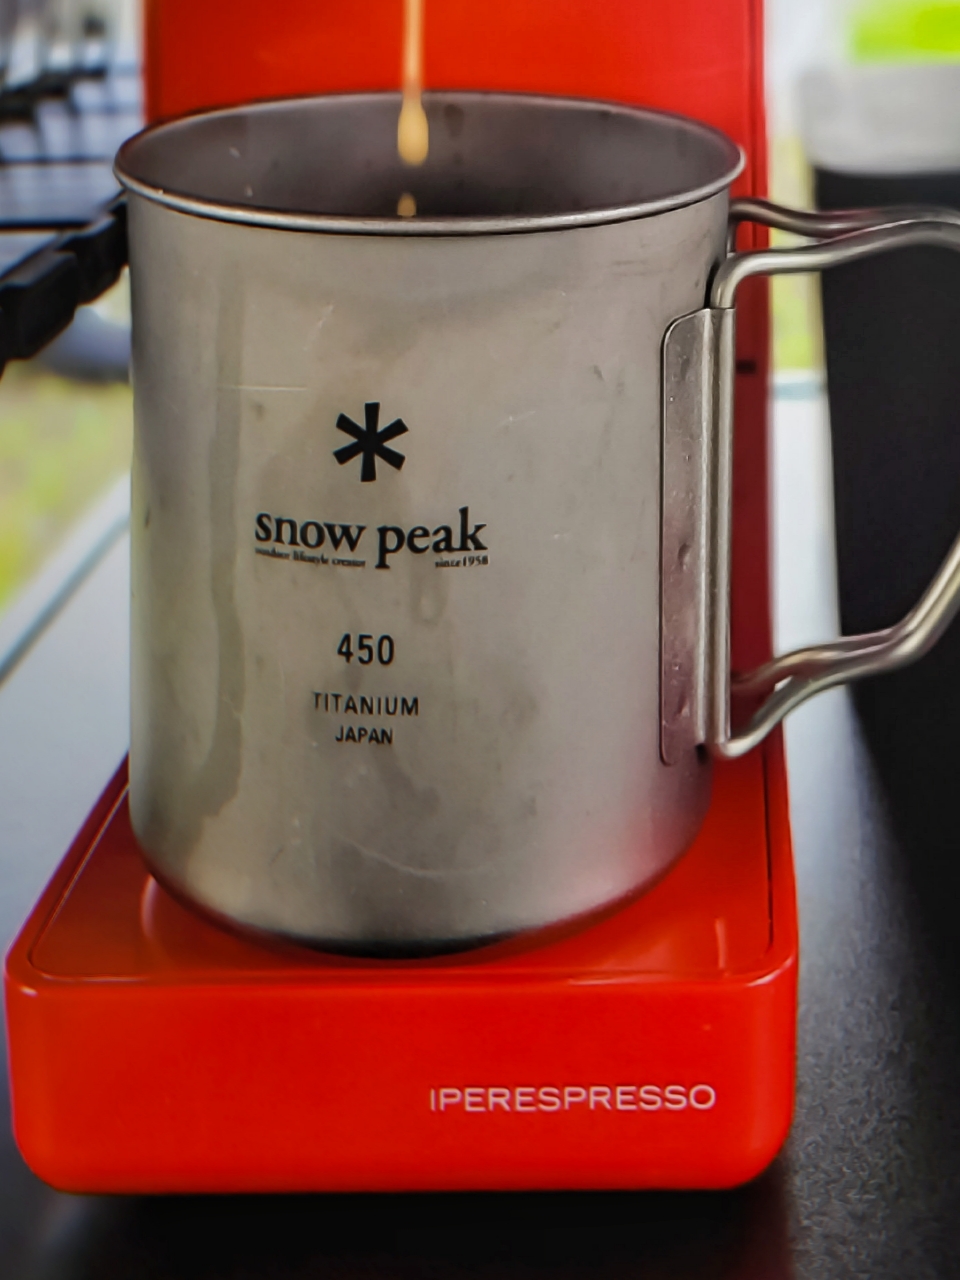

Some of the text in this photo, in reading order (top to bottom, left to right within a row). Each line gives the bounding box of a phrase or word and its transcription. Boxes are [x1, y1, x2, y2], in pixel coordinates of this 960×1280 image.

[255, 506, 488, 570] snow peak
[336, 632, 395, 666] 450
[313, 691, 419, 716] TITANIUM
[335, 724, 393, 745] JAPAN
[430, 1084, 716, 1113] IPERESPRESSO
